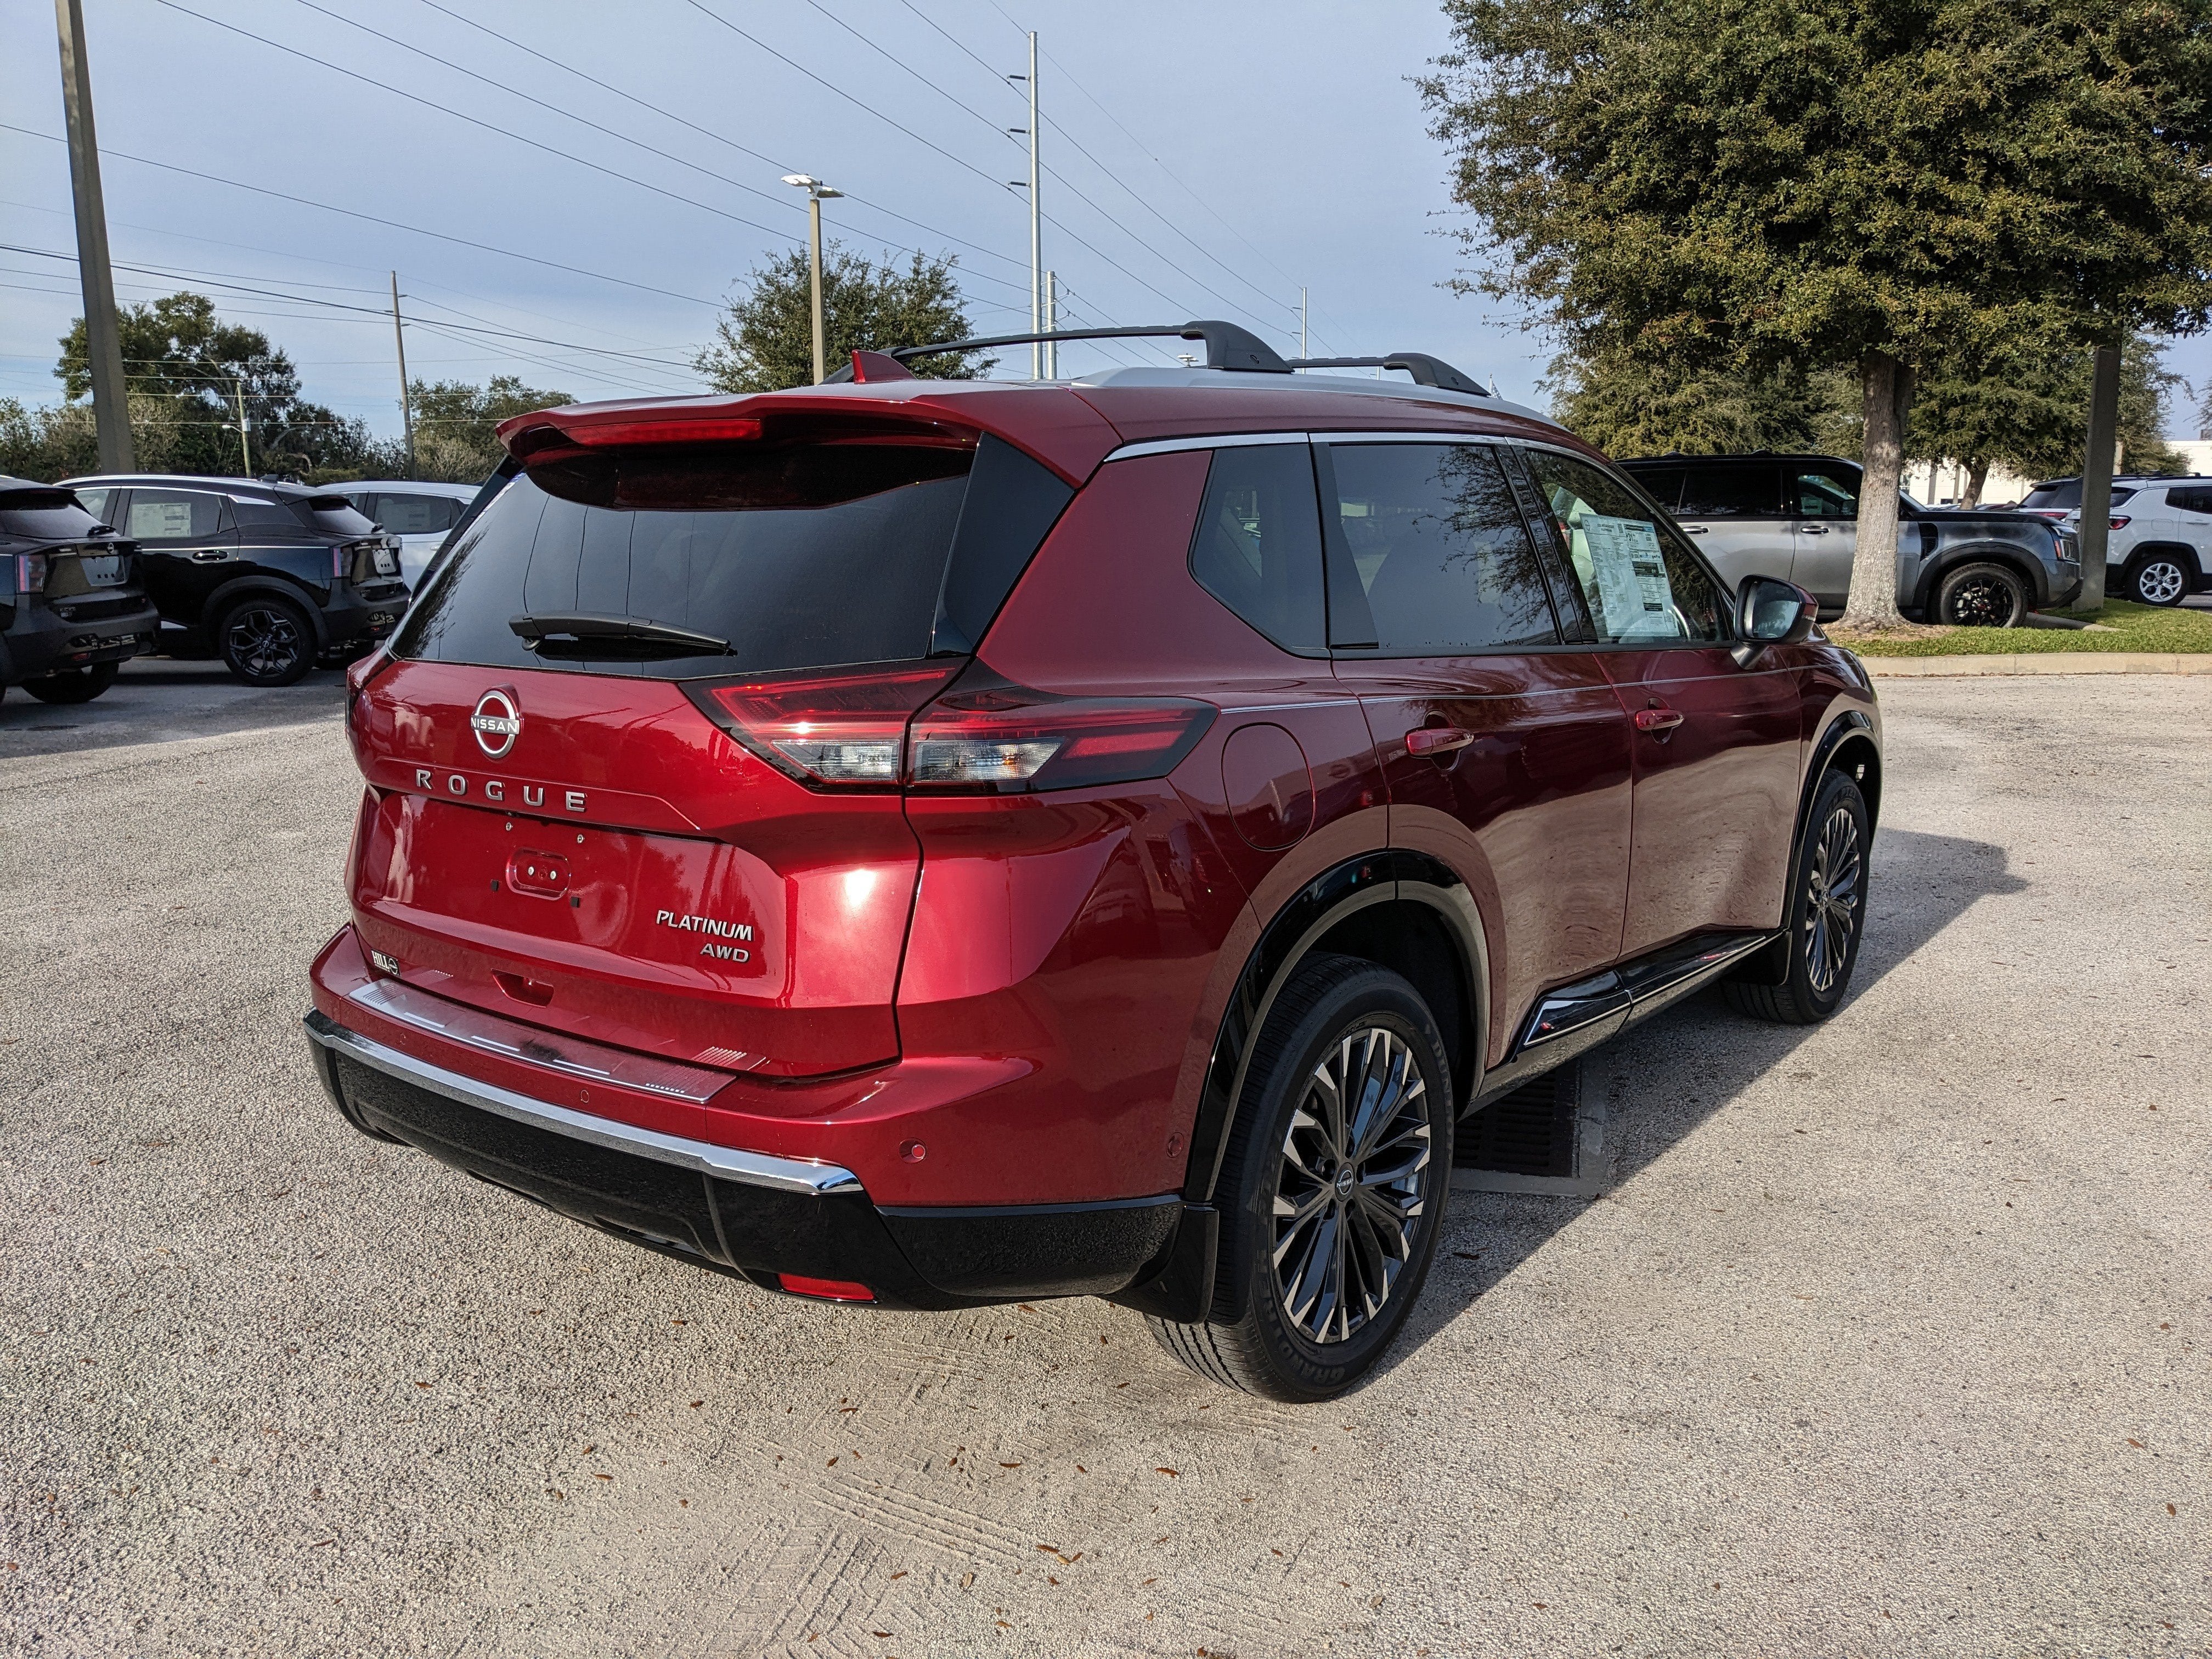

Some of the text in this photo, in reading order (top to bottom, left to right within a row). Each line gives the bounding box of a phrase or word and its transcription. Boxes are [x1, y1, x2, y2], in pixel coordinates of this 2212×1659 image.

[471, 716, 517, 732] NISSAN
[416, 769, 585, 812] ROGUE
[656, 910, 752, 941] PLATINUM
[371, 951, 390, 969] HILL
[699, 943, 749, 963] AWD
